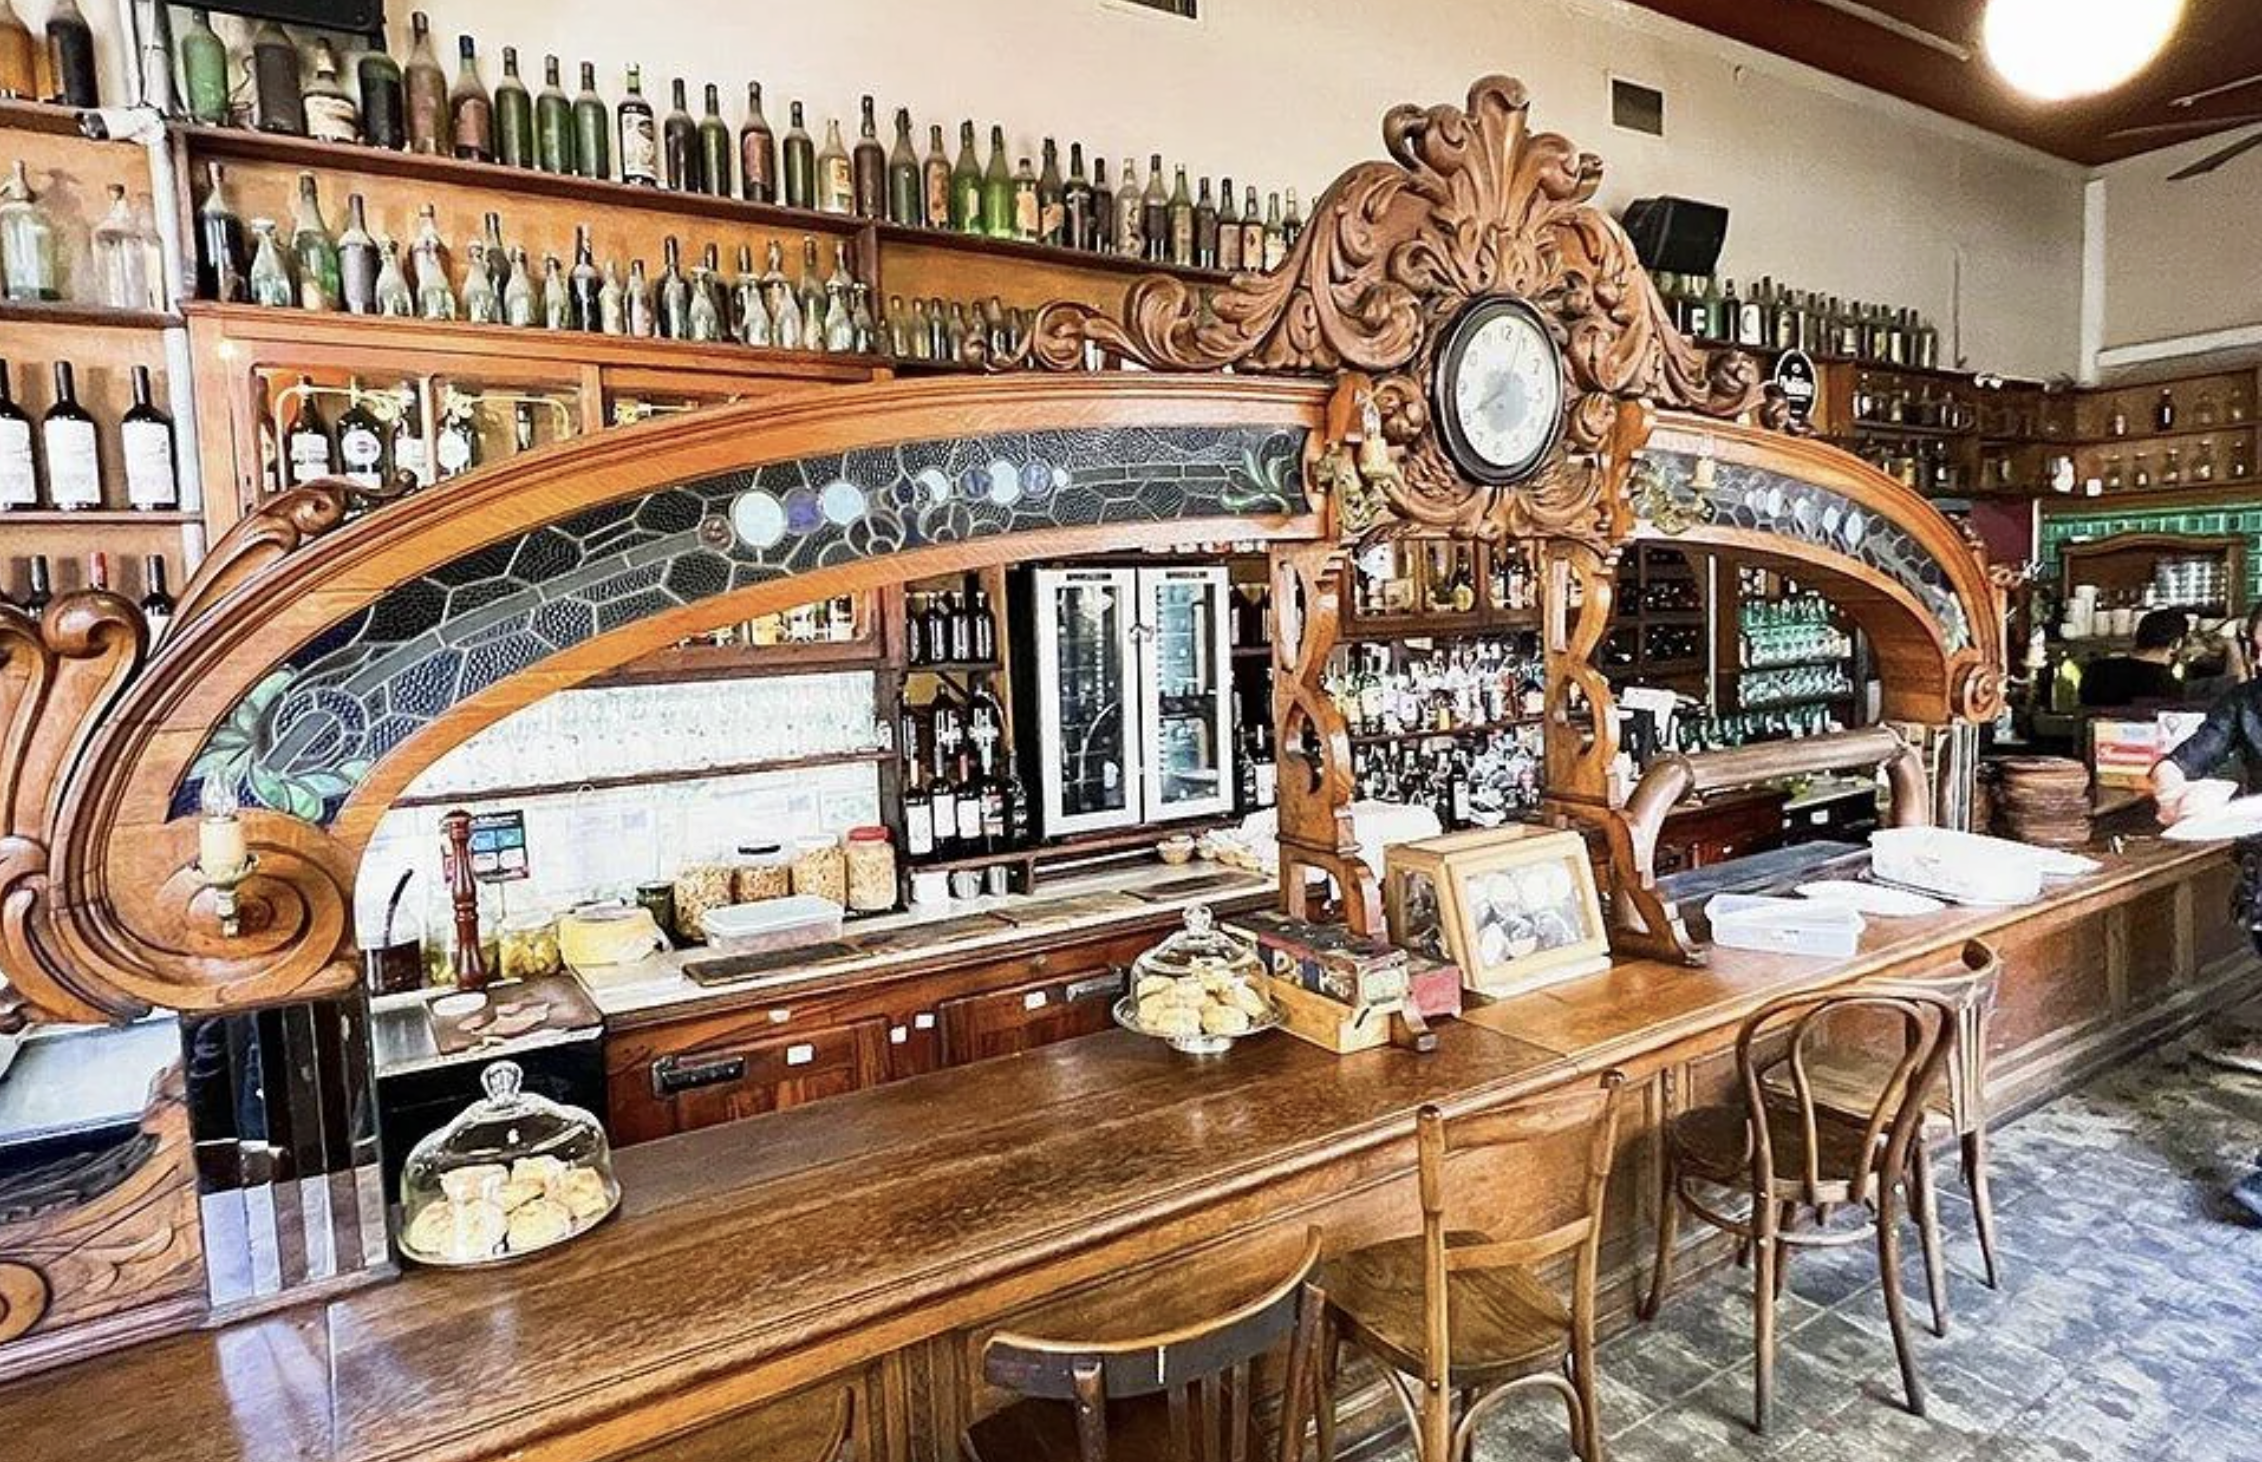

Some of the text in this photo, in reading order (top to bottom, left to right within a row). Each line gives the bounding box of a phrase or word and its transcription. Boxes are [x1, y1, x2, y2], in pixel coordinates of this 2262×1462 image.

[1500, 324, 1512, 343] 12
[1533, 358, 1541, 375] 2
[1536, 386, 1544, 405] 3
